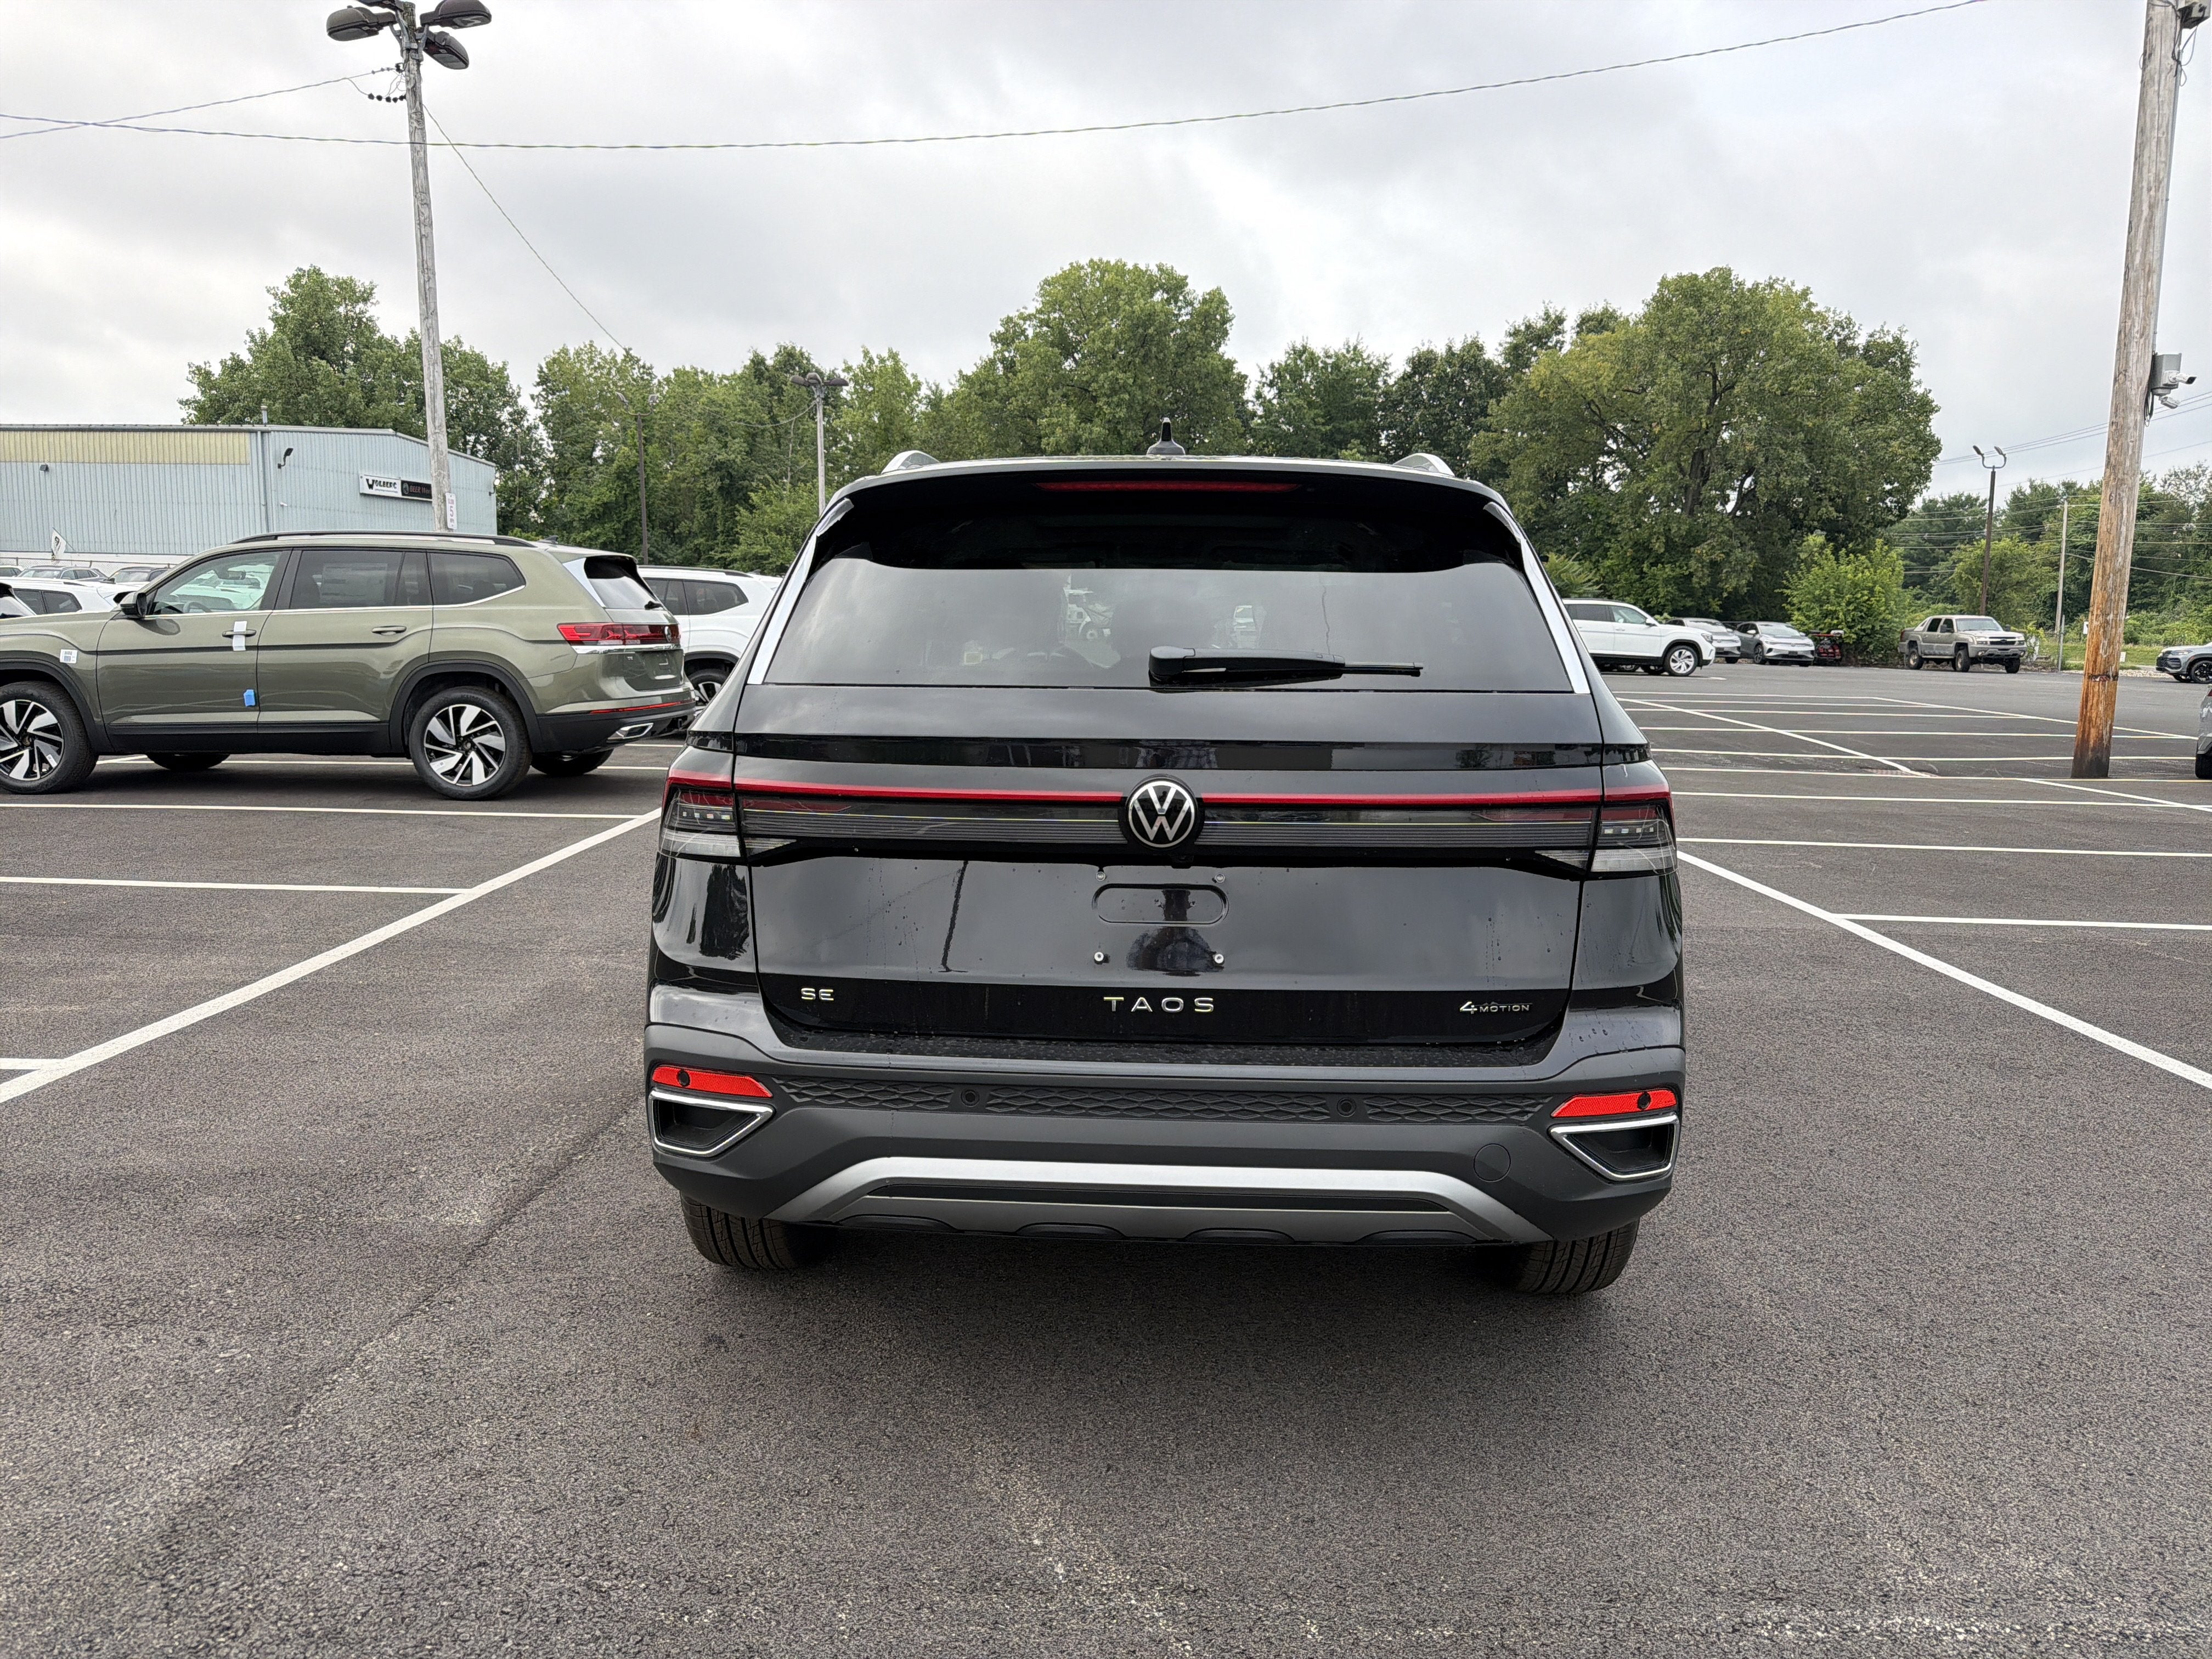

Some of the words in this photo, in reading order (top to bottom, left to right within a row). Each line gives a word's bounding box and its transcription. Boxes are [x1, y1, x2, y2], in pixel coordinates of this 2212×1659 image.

[801, 988, 834, 1001] SE
[1103, 996, 1214, 1012] TAOS
[1459, 1001, 1530, 1014] 4MOTION
